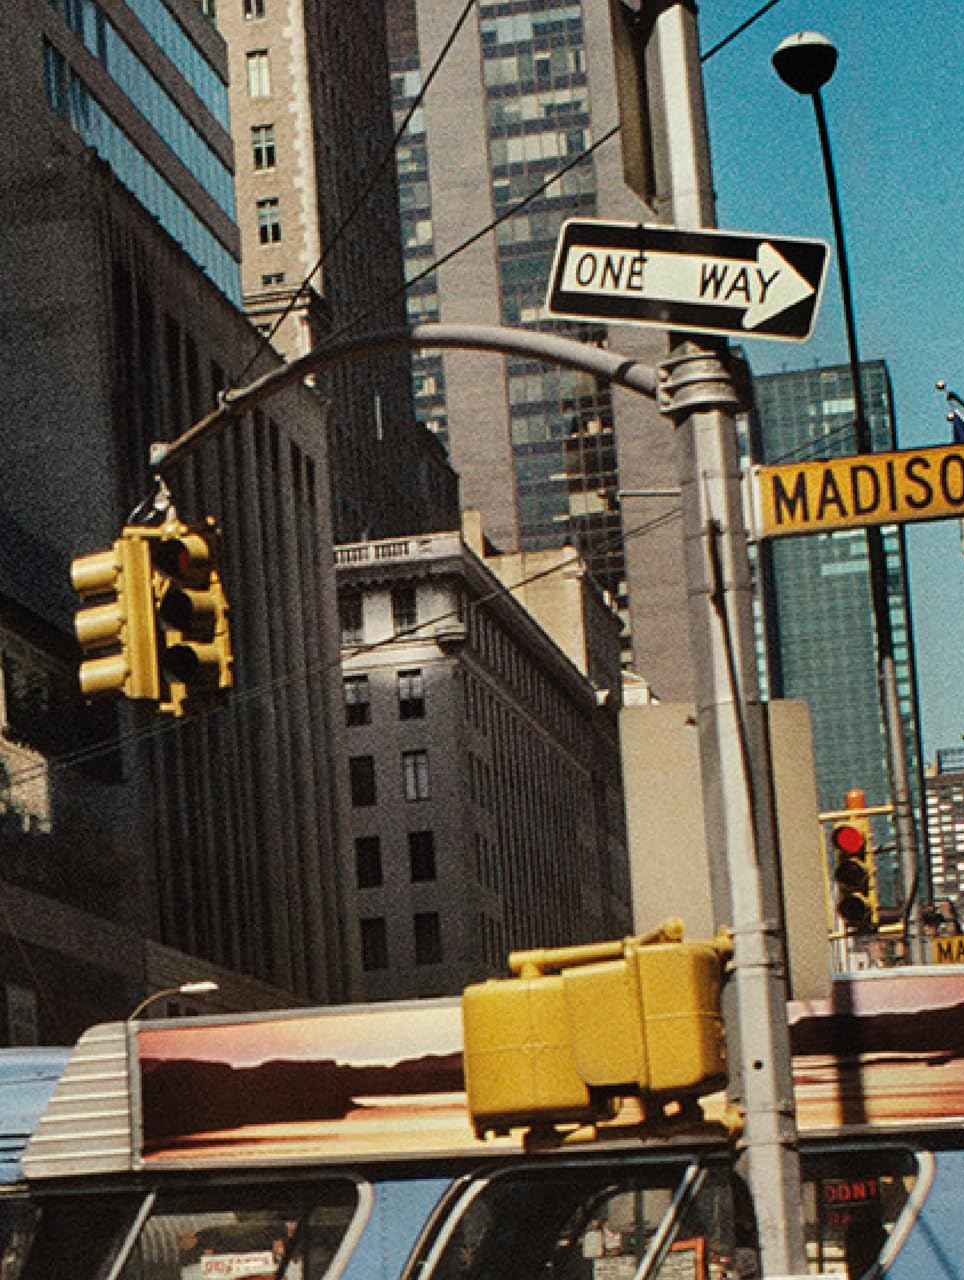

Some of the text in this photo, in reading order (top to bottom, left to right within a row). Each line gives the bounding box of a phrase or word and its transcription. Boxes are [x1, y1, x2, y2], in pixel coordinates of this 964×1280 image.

[575, 253, 780, 304] ONE WAY
[824, 1179, 878, 1202] DONT
